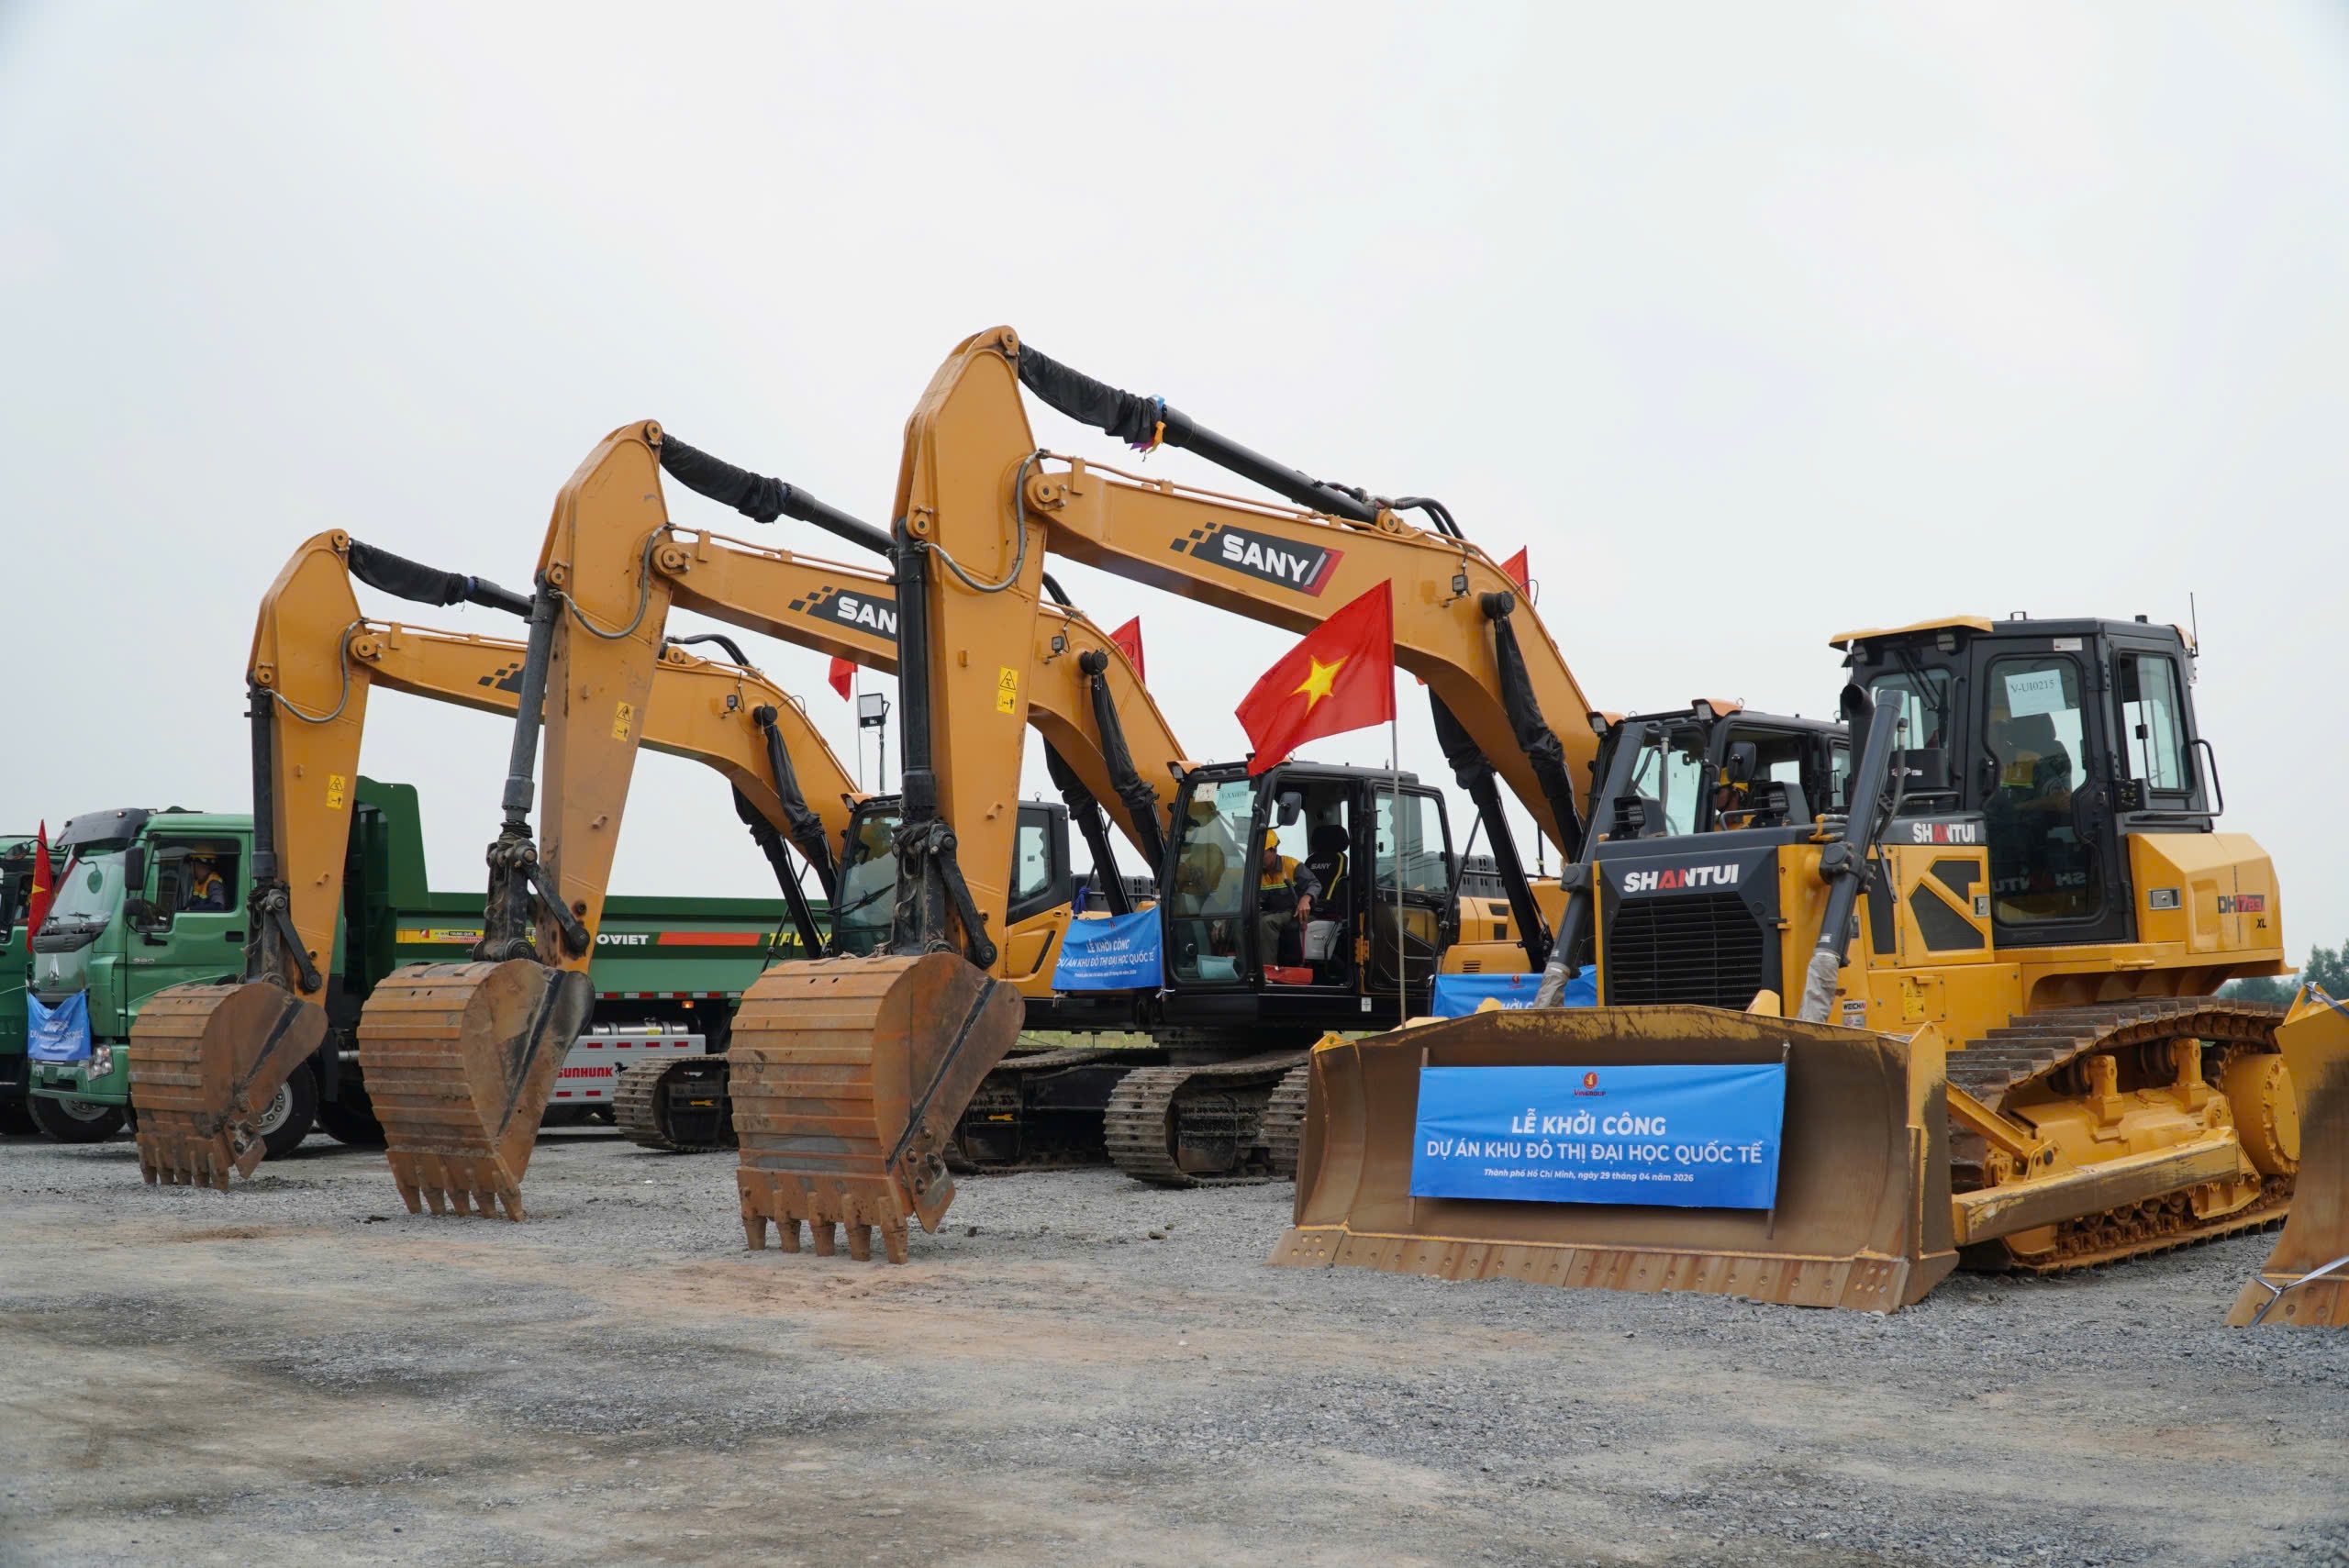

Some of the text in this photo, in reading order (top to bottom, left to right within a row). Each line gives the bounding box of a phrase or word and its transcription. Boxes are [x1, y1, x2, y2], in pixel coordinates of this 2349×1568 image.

[1222, 534, 1309, 583] SANY
[837, 596, 896, 634] SAN
[1913, 822, 1976, 843] SHANTUI
[1623, 864, 1740, 892] SHANTUI
[2256, 918, 2266, 929] XL
[1502, 998, 1524, 1009] HỞI
[1512, 1108, 1666, 1137] LỄ KHỞI CÔNG
[1427, 1138, 1765, 1165] DỰ ÁN KHU ĐÔ THỊ ĐẠI HỌC QUỐC TẾ
[1484, 1168, 1695, 1182] Thành phố Hồ Chí Minh, ngày 29 tháng 04 năm 2026
